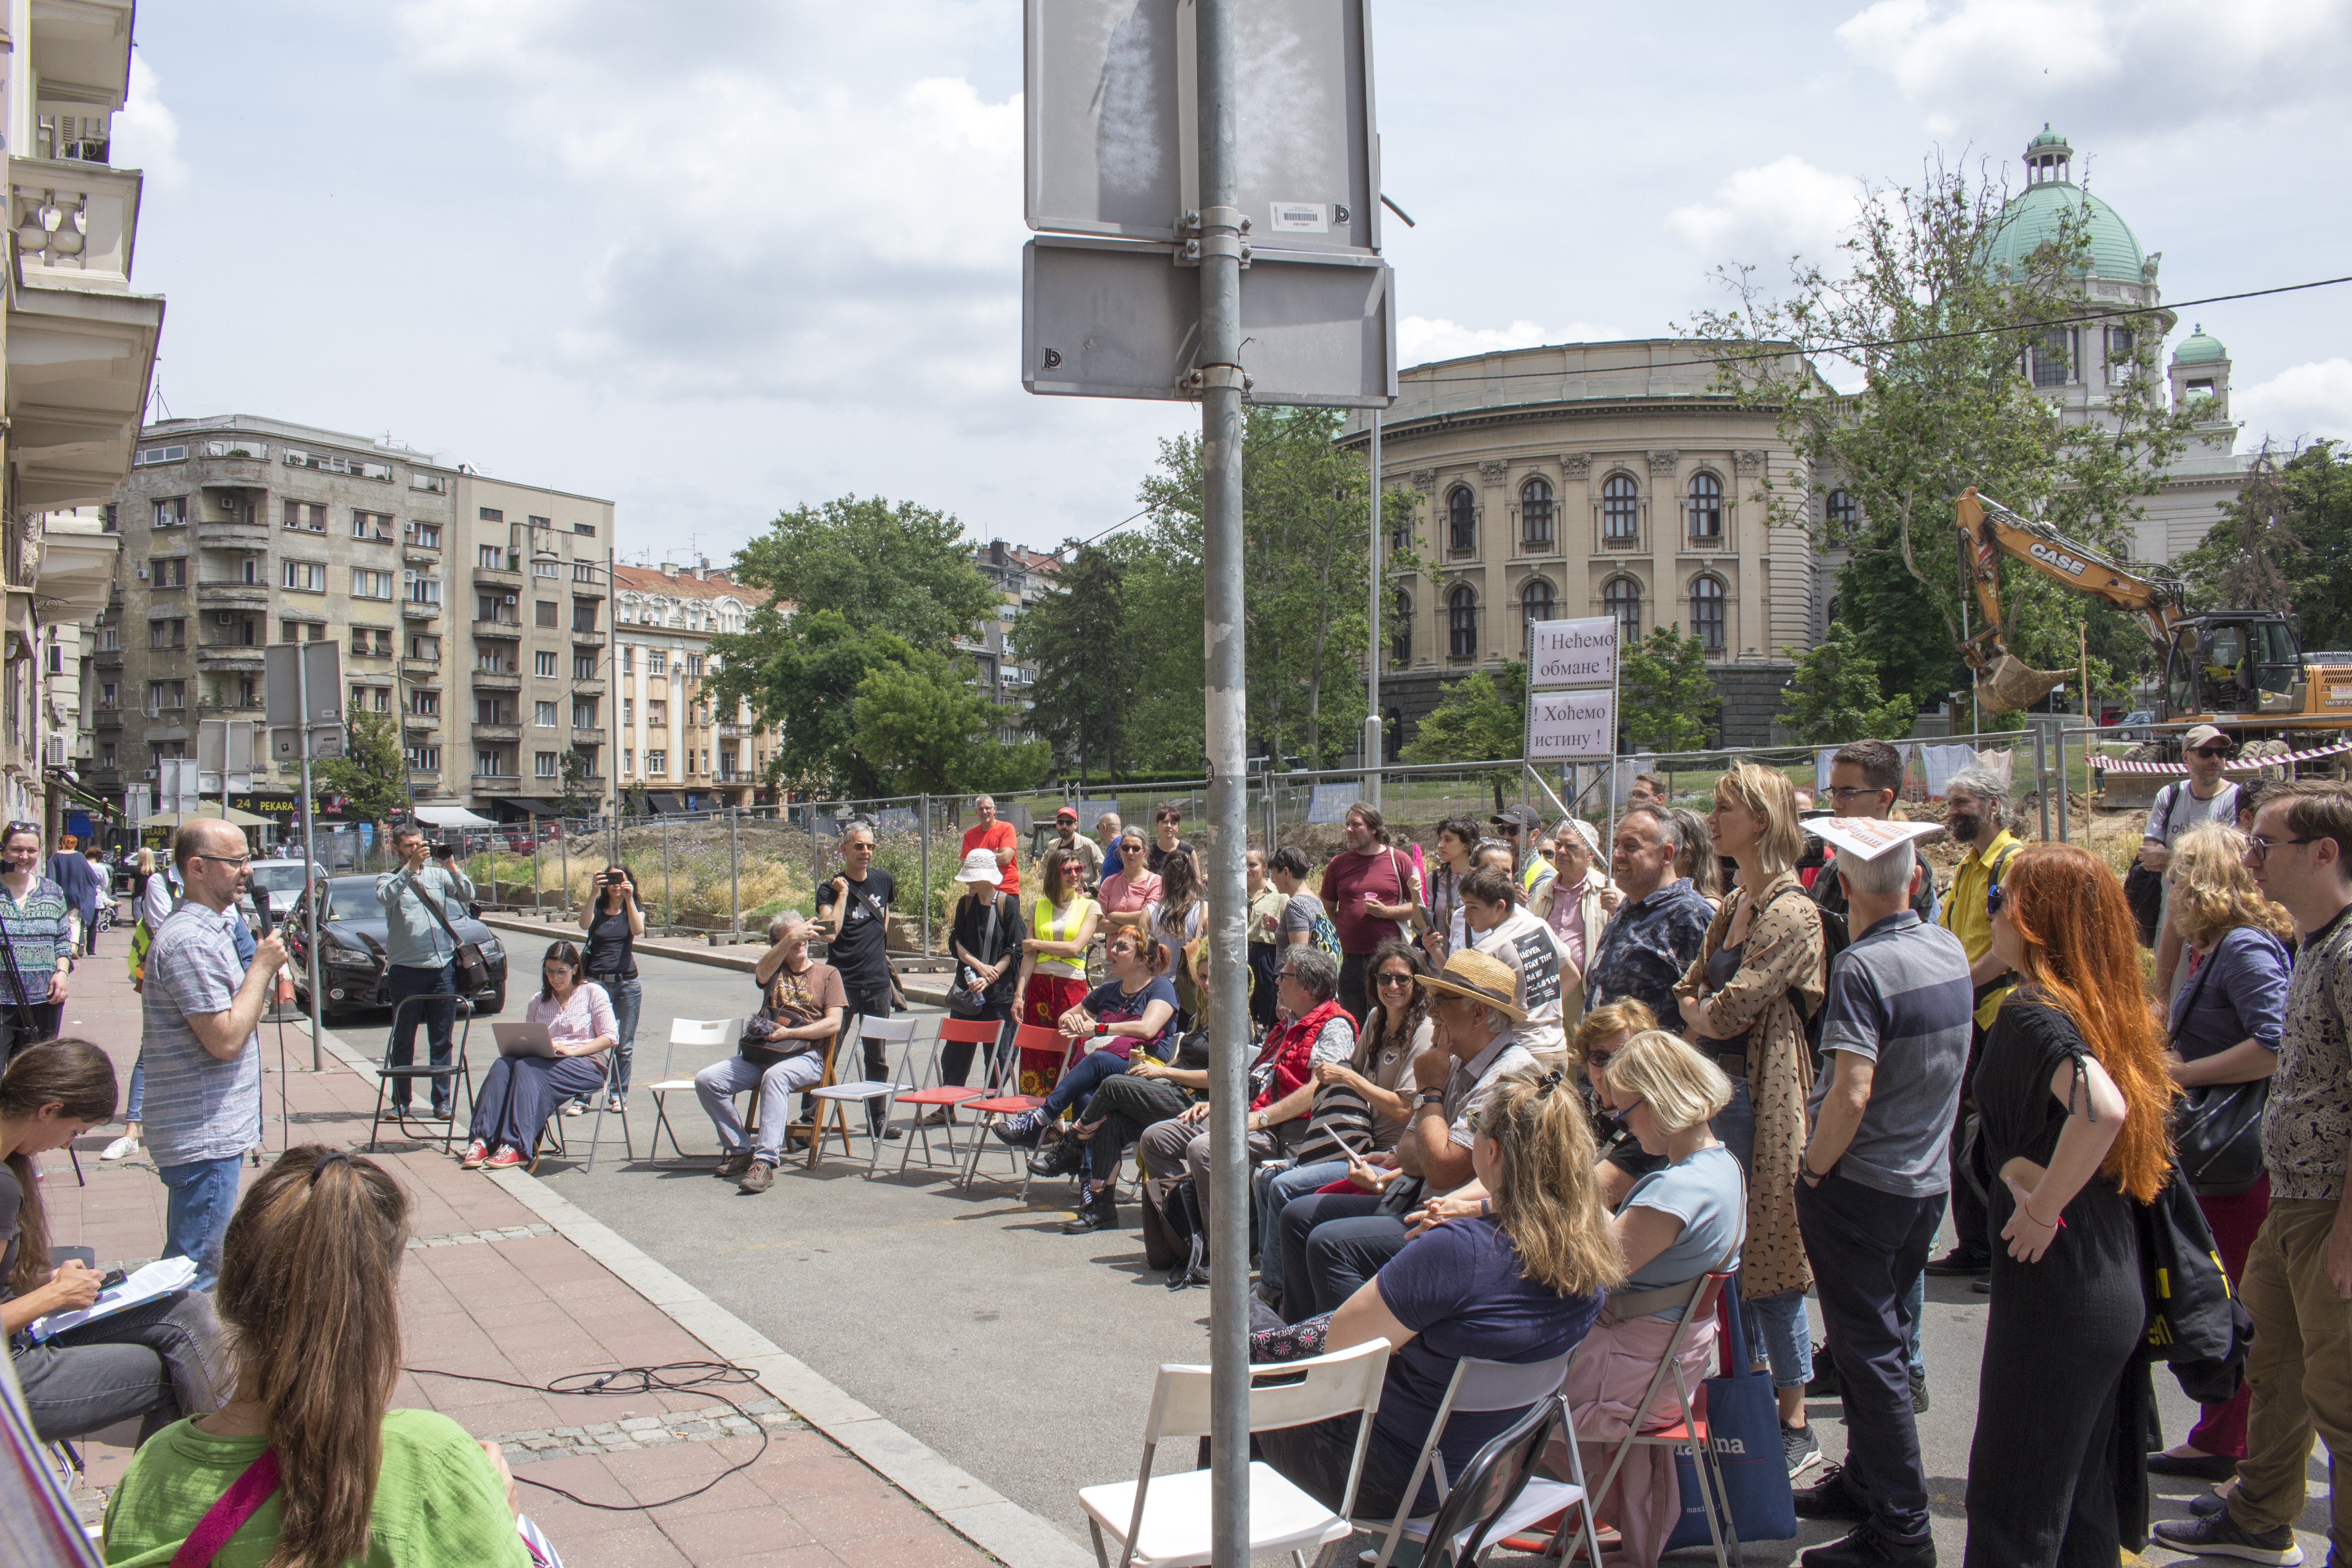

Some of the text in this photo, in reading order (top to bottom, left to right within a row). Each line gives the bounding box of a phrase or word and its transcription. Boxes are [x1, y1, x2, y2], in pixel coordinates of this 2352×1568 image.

[2029, 542, 2087, 576] CASE
[1551, 632, 1614, 649] Нећемо
[1541, 660, 1599, 676] обмане
[1544, 705, 1605, 721] Хоћемо
[1535, 734, 1591, 750] истину
[236, 799, 251, 808] 24
[260, 801, 294, 810] PEKARA
[141, 827, 167, 835] PEKARA
[1524, 952, 1553, 971] STAY THE
